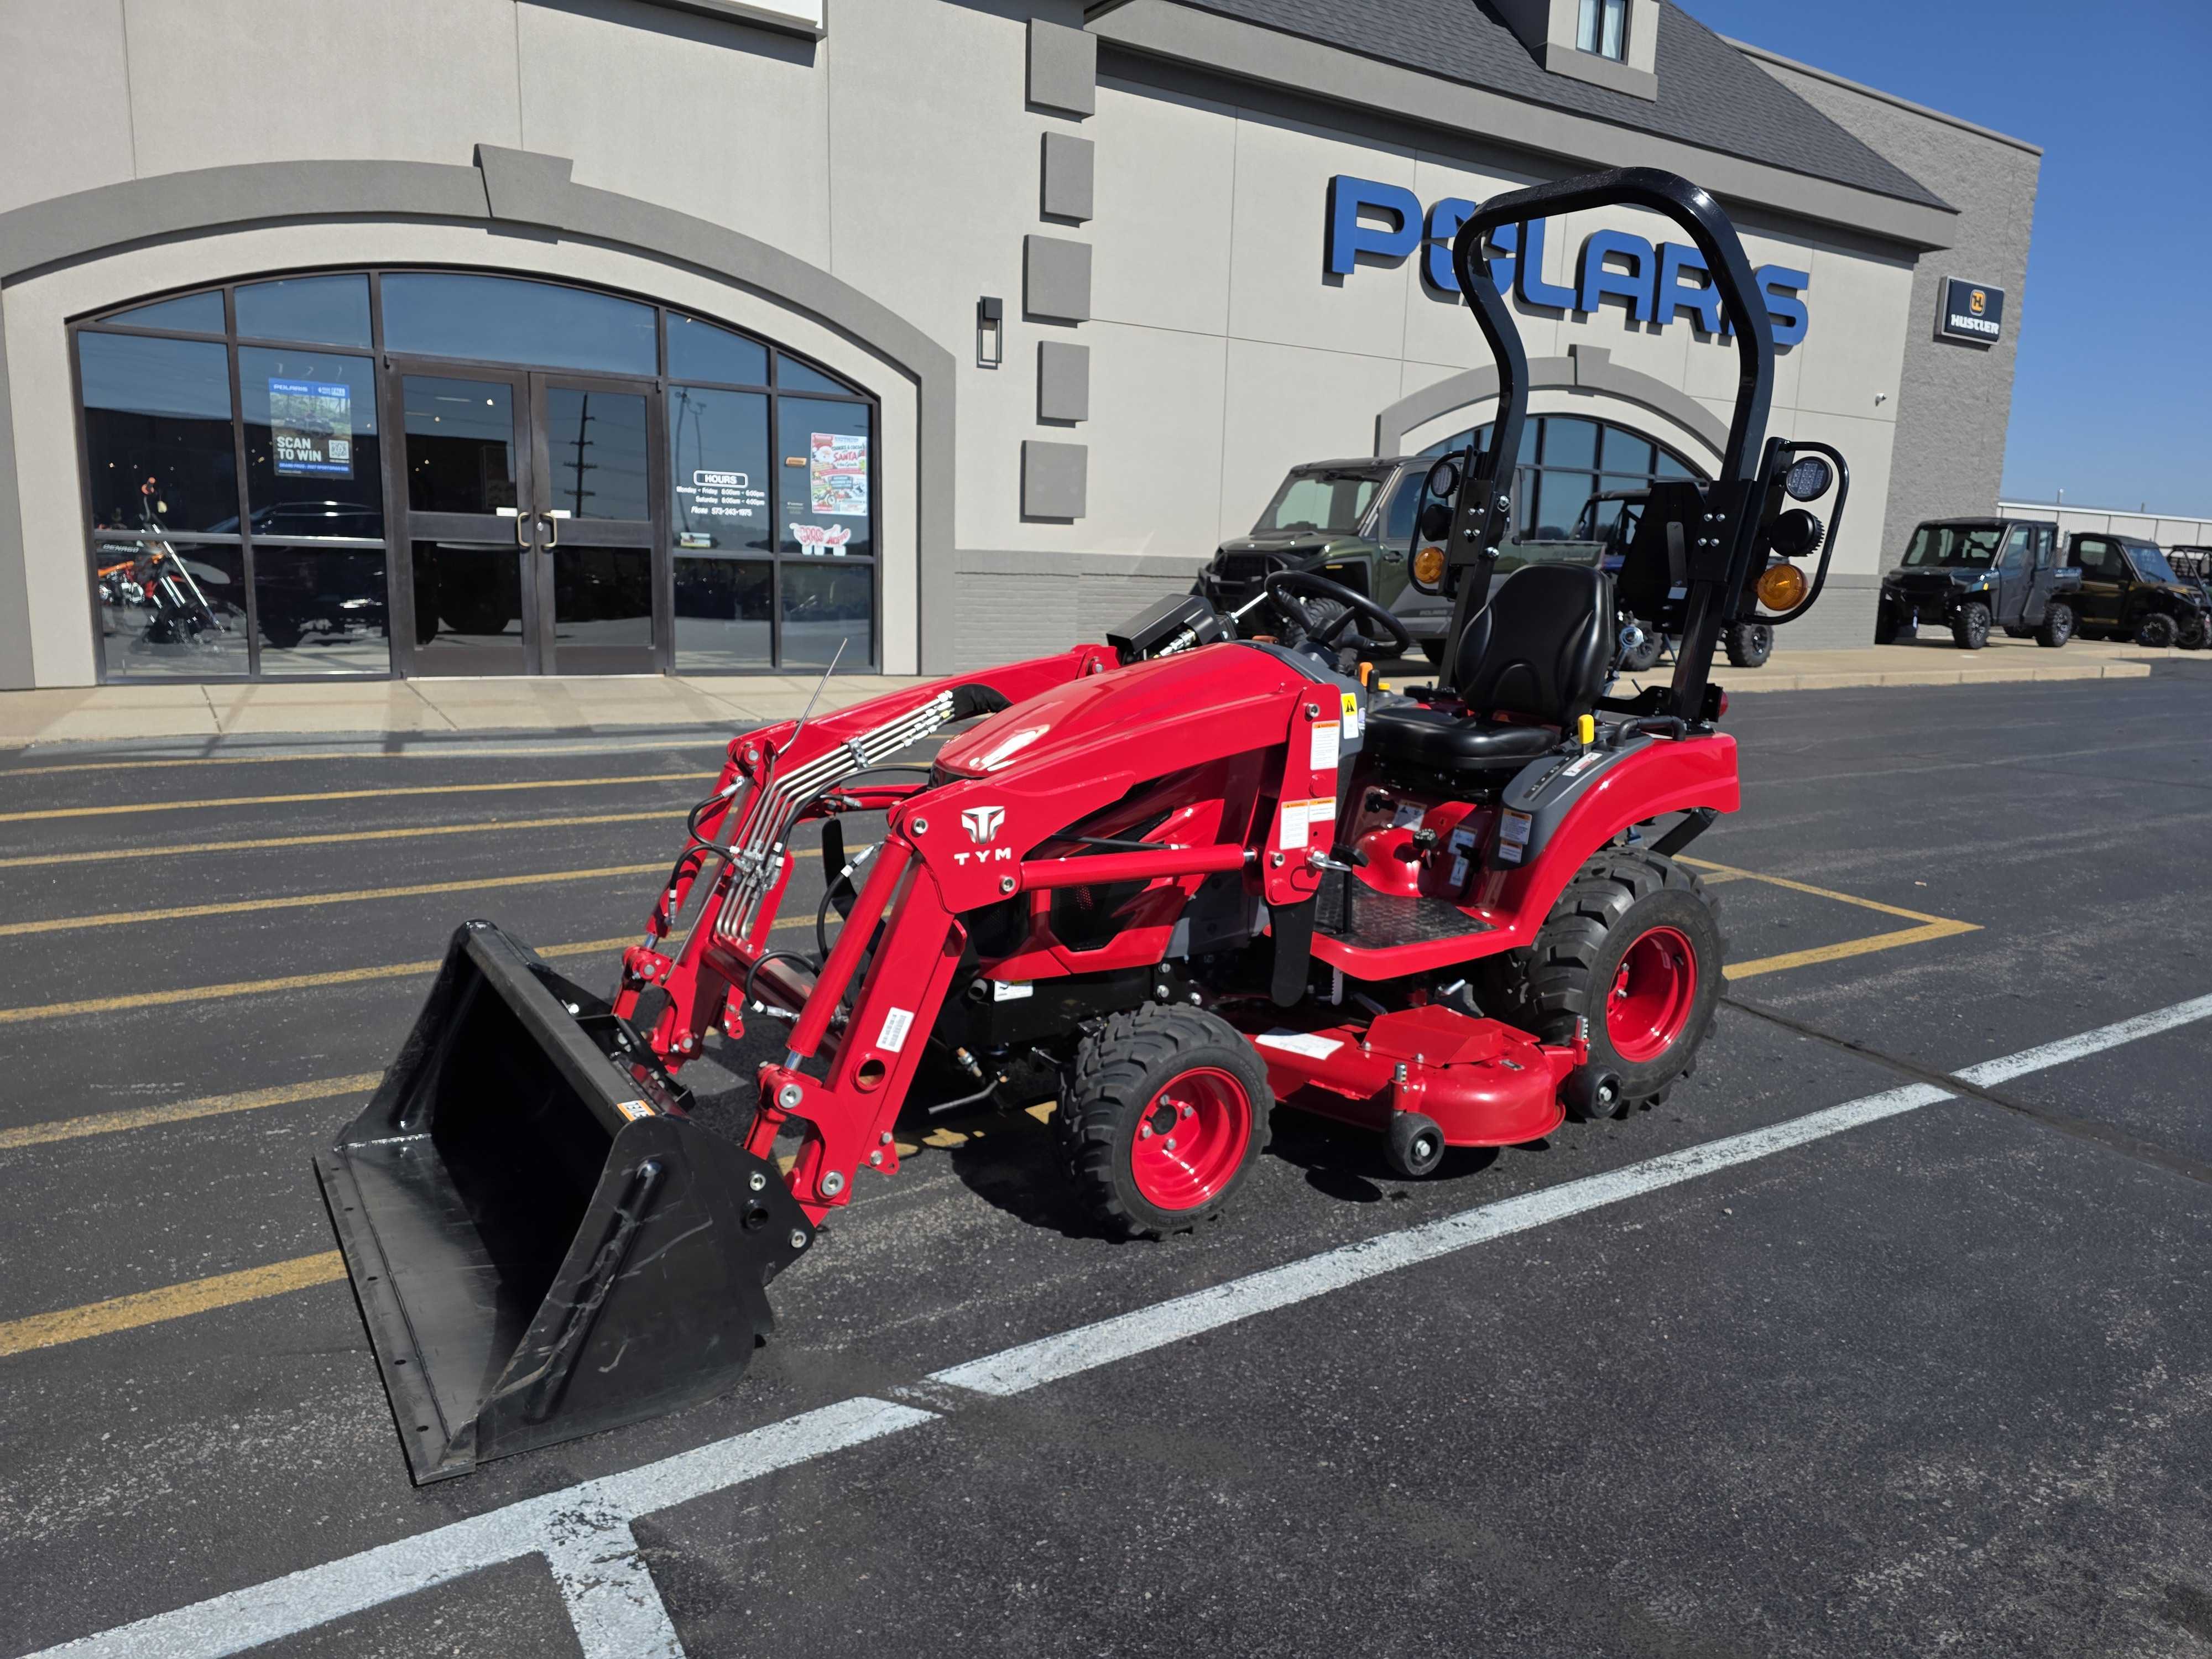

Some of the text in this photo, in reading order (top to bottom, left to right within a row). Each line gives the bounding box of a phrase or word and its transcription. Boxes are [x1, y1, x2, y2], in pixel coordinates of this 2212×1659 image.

[1325, 174, 1810, 346] POLARS
[1950, 314, 2000, 335] HUSTLER
[277, 436, 311, 449] SCAN
[278, 448, 322, 462] TO WIN
[833, 451, 857, 462] SANTA
[705, 474, 738, 484] HOURS
[954, 847, 1011, 865] TYM
